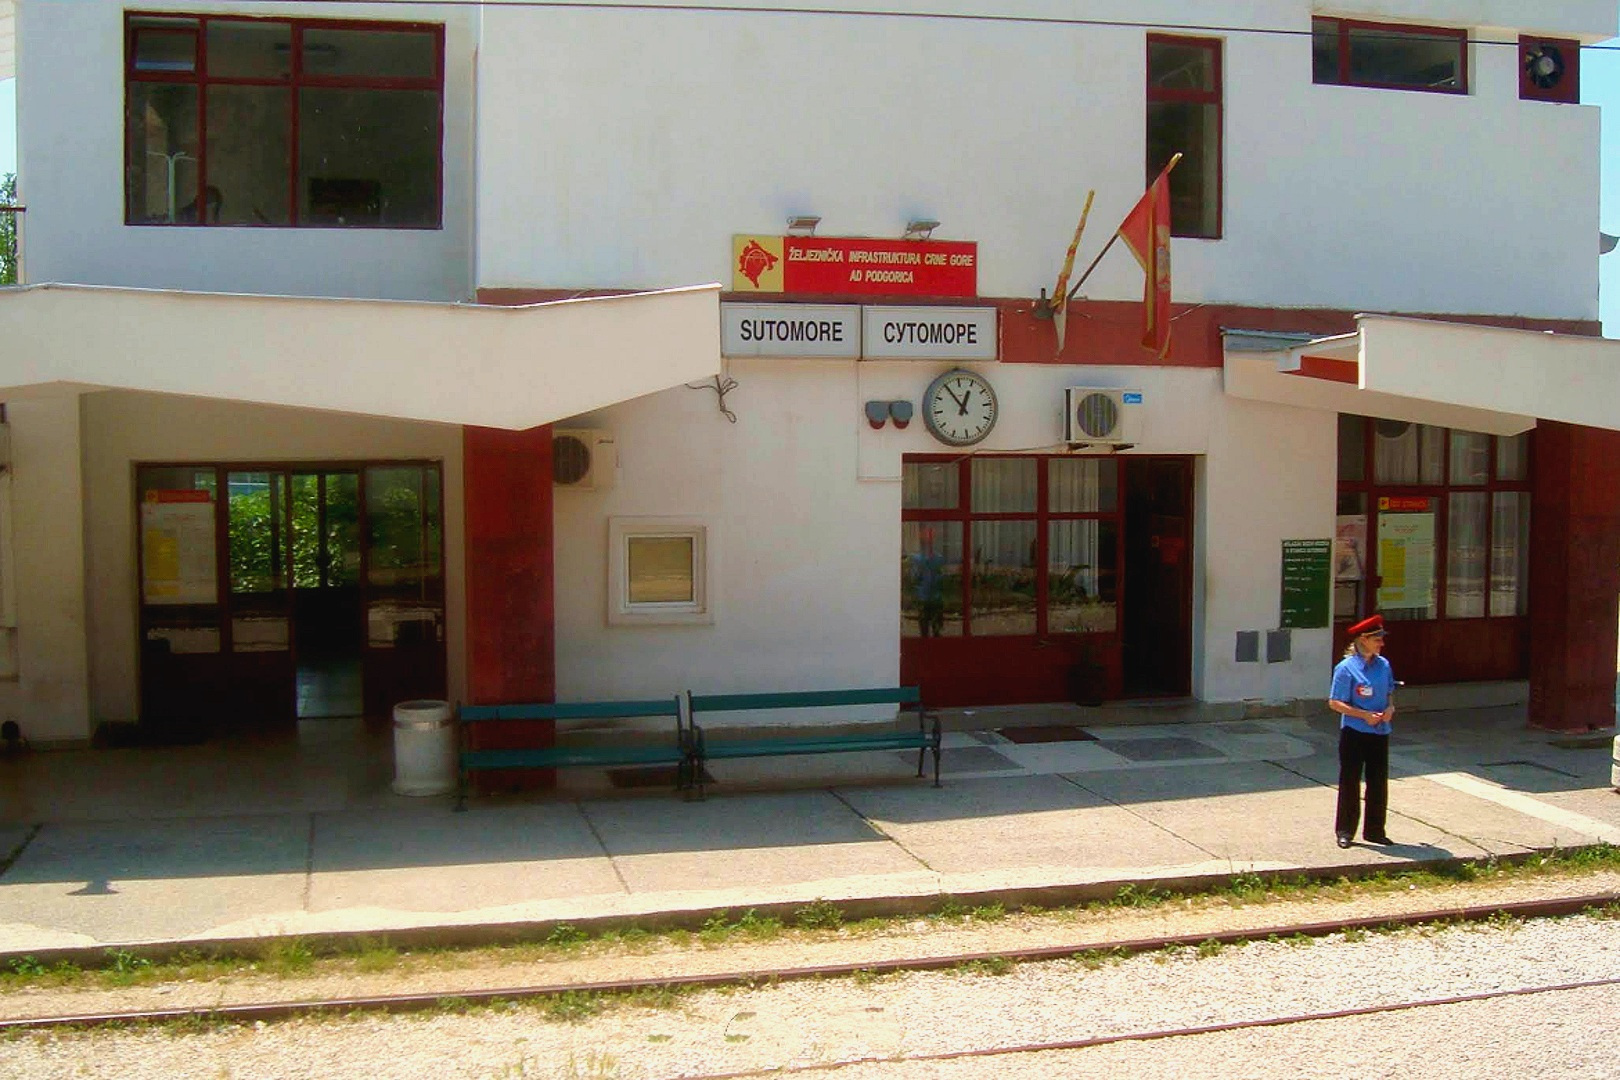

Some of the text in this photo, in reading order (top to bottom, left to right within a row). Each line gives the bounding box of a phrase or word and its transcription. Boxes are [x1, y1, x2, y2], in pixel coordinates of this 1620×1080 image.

[789, 246, 973, 266] ŽELJEZNIČKA INFRASTRUKTURA CRNE GORE
[850, 269, 913, 283] AD PODGORICA
[740, 319, 843, 342] SUTOMORE
[884, 322, 977, 344] СУТОМОРЕ
